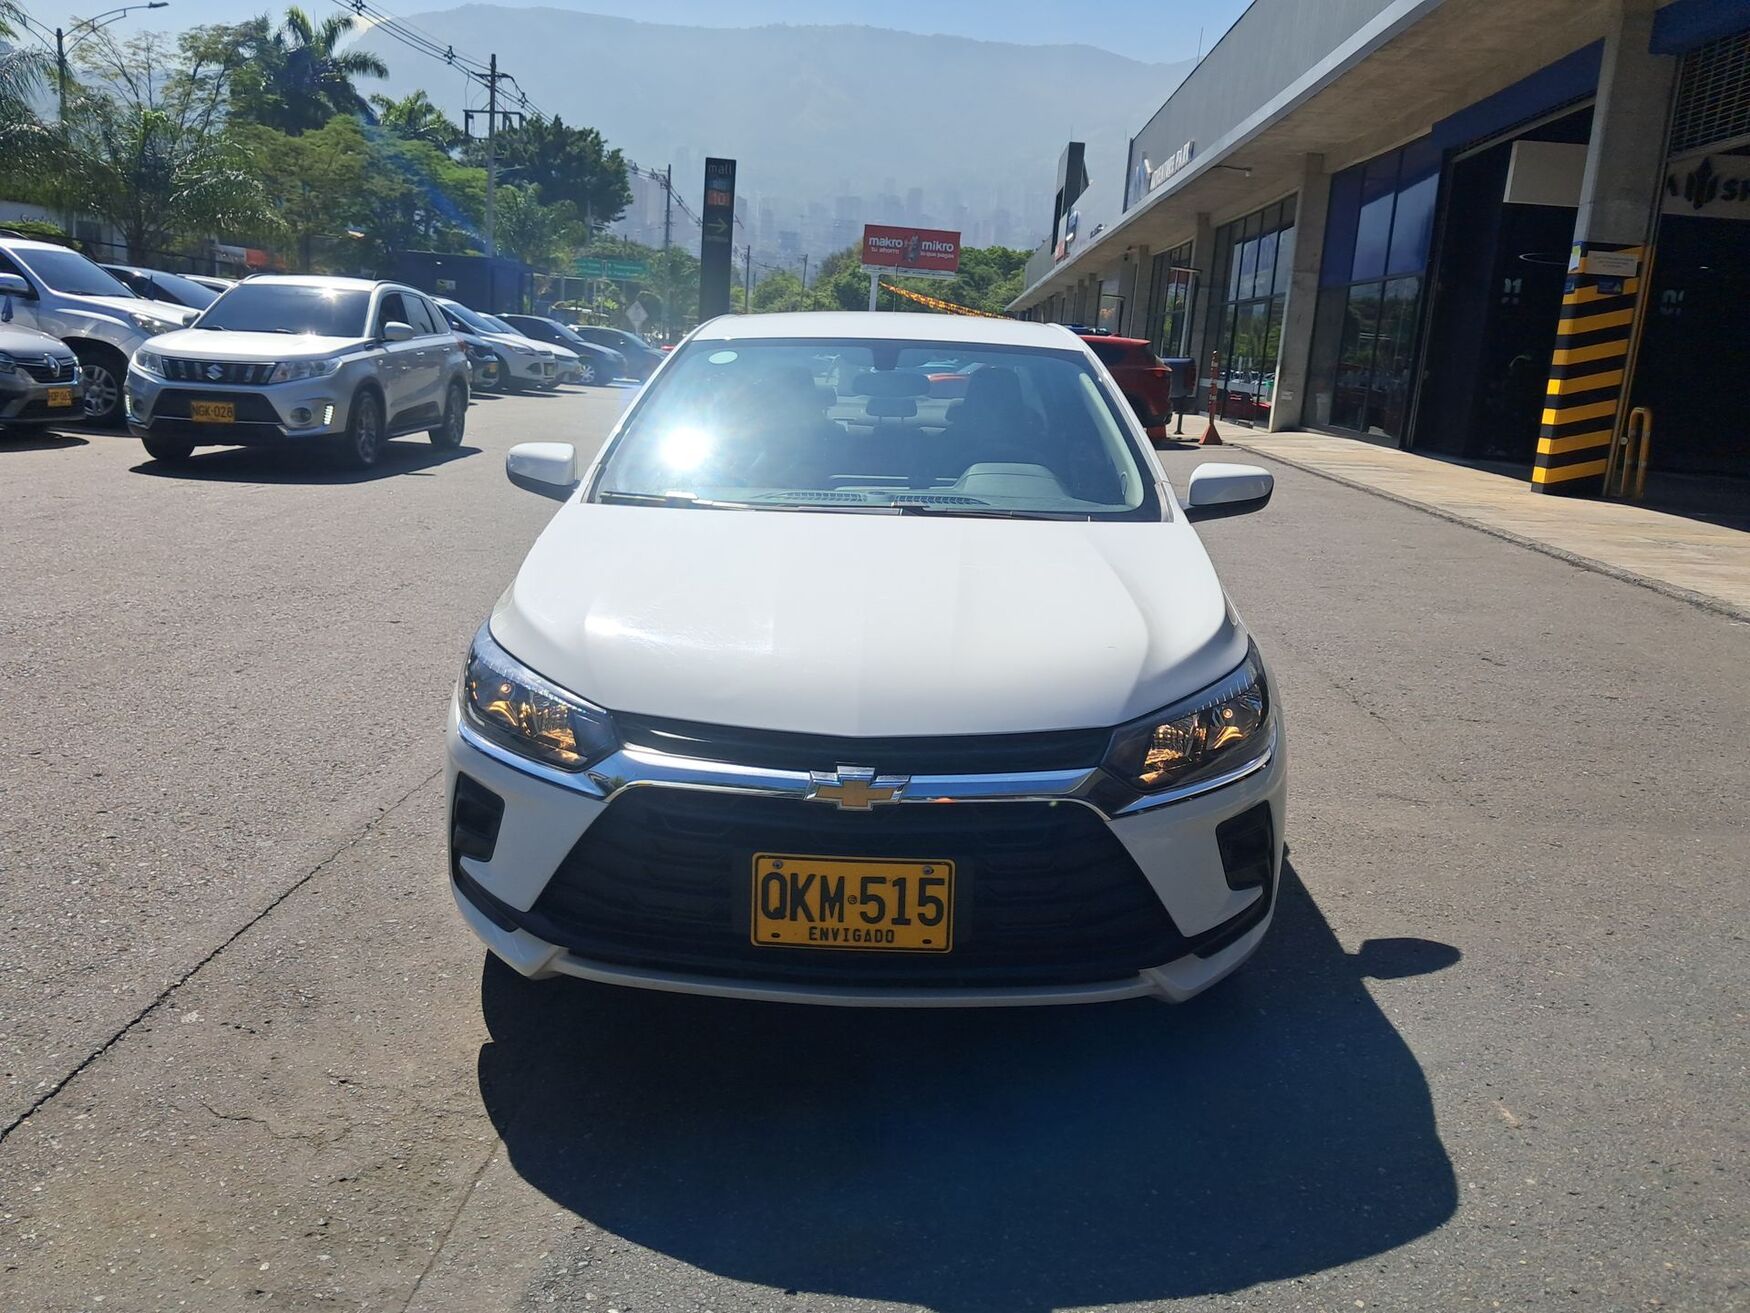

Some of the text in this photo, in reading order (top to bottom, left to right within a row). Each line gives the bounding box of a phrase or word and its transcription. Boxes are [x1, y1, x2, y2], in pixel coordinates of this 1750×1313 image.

[708, 163, 732, 175] mall
[868, 236, 954, 252] makro mikro
[808, 926, 895, 943] ENVIGADO
